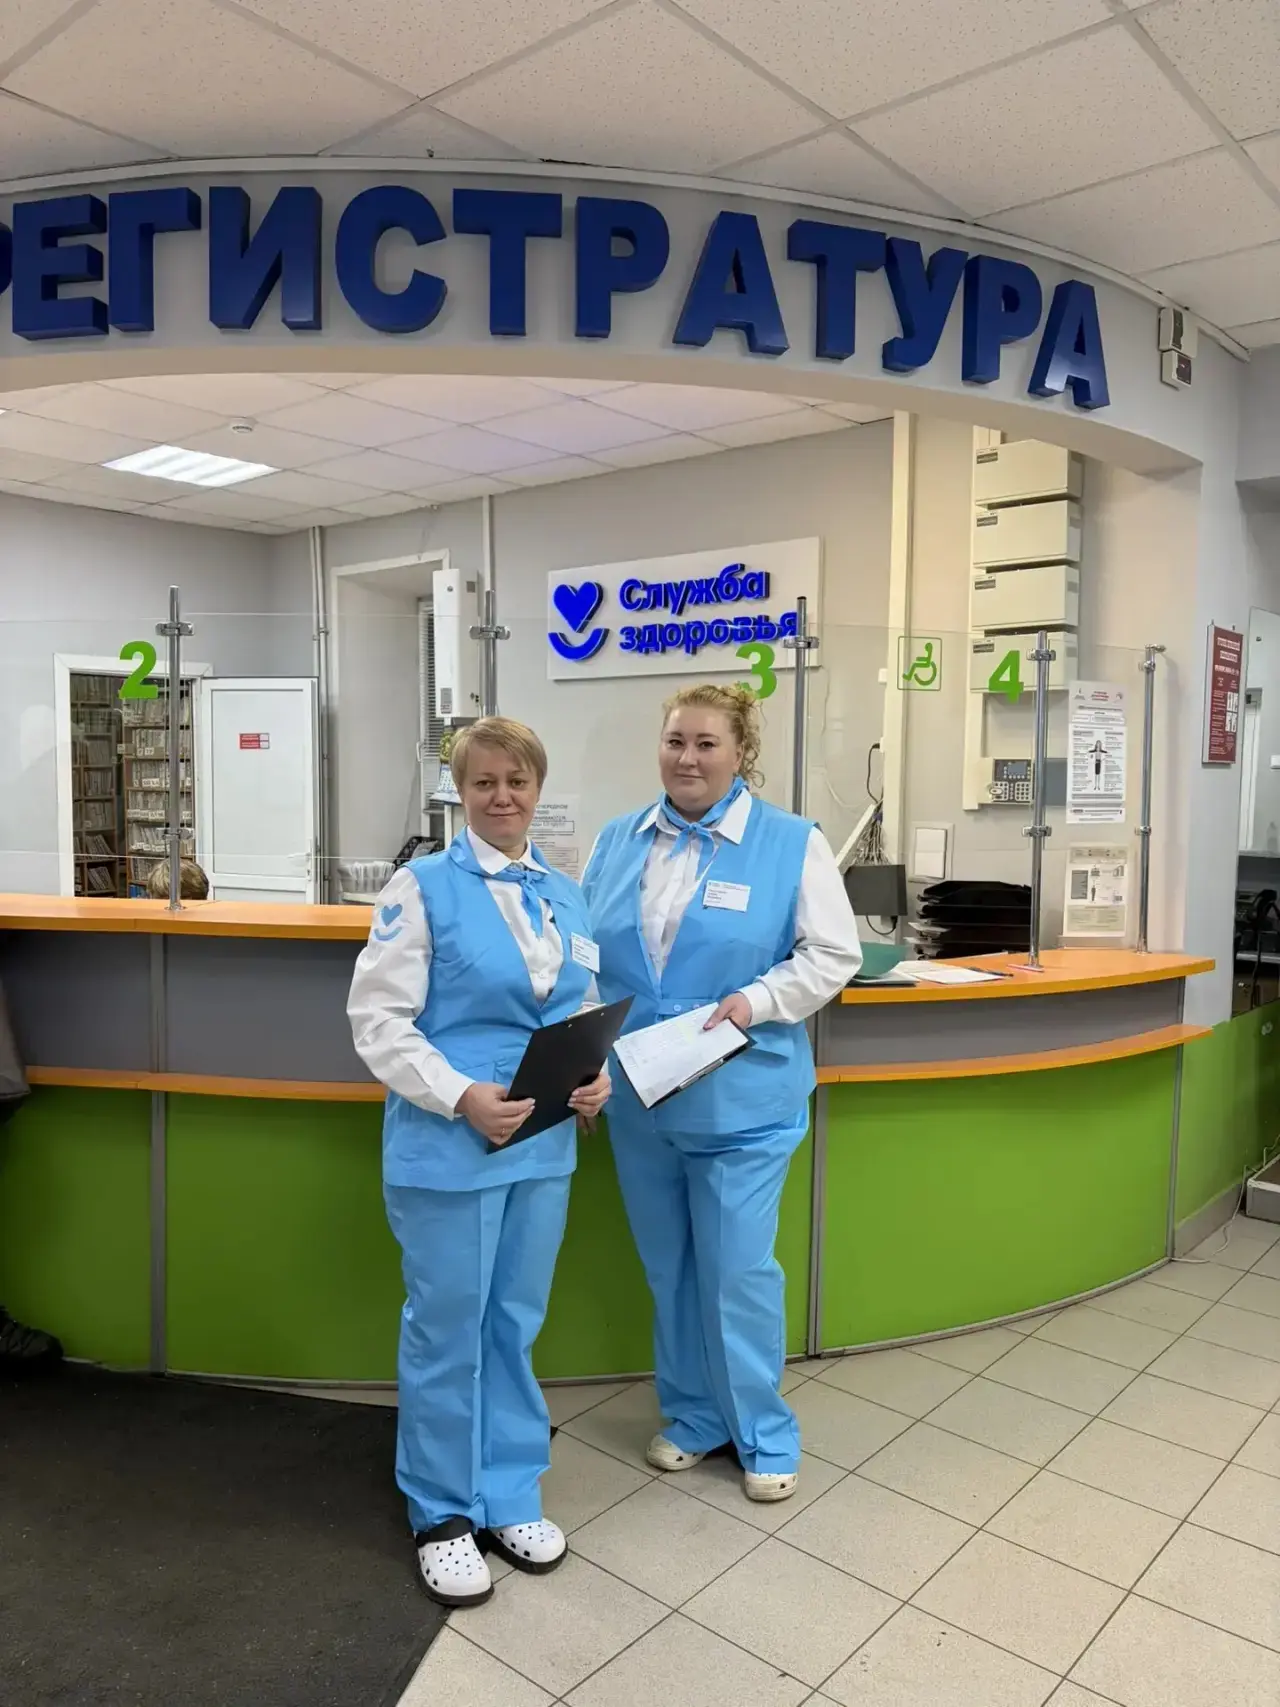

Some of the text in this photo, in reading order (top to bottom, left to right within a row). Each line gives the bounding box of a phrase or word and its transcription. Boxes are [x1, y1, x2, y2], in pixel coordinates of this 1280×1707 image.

[0, 185, 1111, 410] ЕГИСТРАТУРА
[619, 562, 770, 616] Служба
[619, 611, 798, 655] здоровья
[119, 640, 158, 699] 2
[736, 642, 778, 700] 3
[988, 650, 1025, 704] 4
